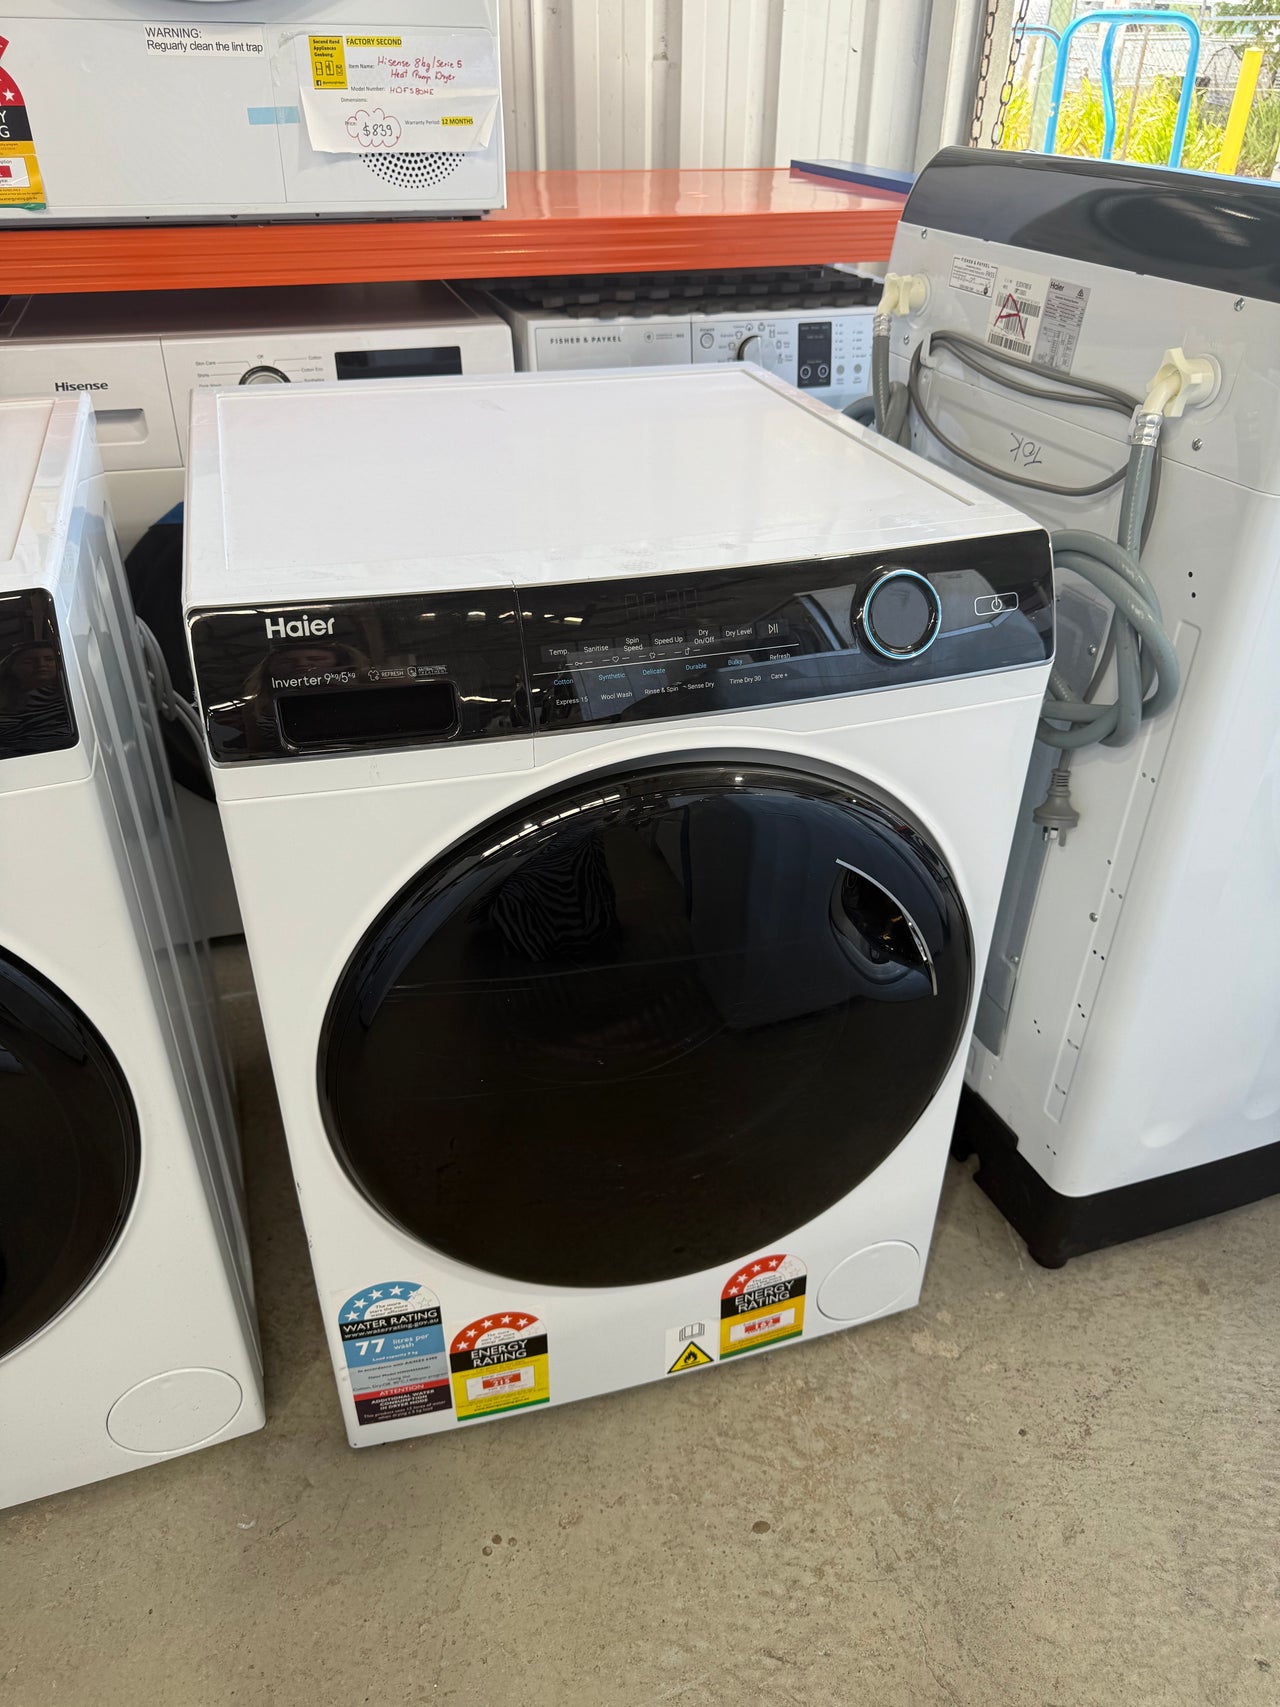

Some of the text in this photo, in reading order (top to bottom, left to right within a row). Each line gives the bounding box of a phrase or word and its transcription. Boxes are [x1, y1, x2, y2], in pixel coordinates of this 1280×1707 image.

[145, 27, 202, 39] WARNING:
[147, 40, 263, 54] Reguarly clean the lint trap
[346, 38, 402, 46] FACTORY SECOND
[378, 56, 410, 67] Hisense
[391, 69, 408, 79] Heat
[435, 71, 455, 84] Dryer
[363, 122, 393, 137] $839
[1050, 281, 1065, 291] Haier
[993, 293, 1025, 340] A
[54, 380, 109, 393] Hisense
[265, 614, 335, 639] Haier
[698, 629, 708, 637] Dry
[726, 627, 752, 638] Dry Level
[626, 637, 640, 645] Spin
[654, 637, 674, 645] Speed
[694, 636, 715, 645] On/Off
[583, 645, 609, 654] Sanitise
[623, 644, 644, 652] Speed
[685, 662, 707, 670] Durable
[381, 670, 404, 678] REFRESH
[598, 672, 625, 682] Synthetic
[642, 668, 666, 676] Delicate
[271, 675, 322, 689] Inverter
[553, 678, 574, 686] Cotton
[687, 681, 715, 690] Sense Dry
[744, 676, 754, 684] Dry
[556, 698, 580, 706] Express
[735, 1280, 794, 1306] ENERGY
[738, 1290, 790, 1313] RATING
[343, 1309, 438, 1332] WATER RATING
[392, 1333, 430, 1345] litres per
[355, 1337, 386, 1356] 77
[393, 1342, 415, 1350] wash
[471, 1339, 528, 1360] ENERGY
[473, 1348, 527, 1368] RATING
[380, 1384, 424, 1396] ATTENTION
[371, 1389, 435, 1405] ADDITIONAL WATER
